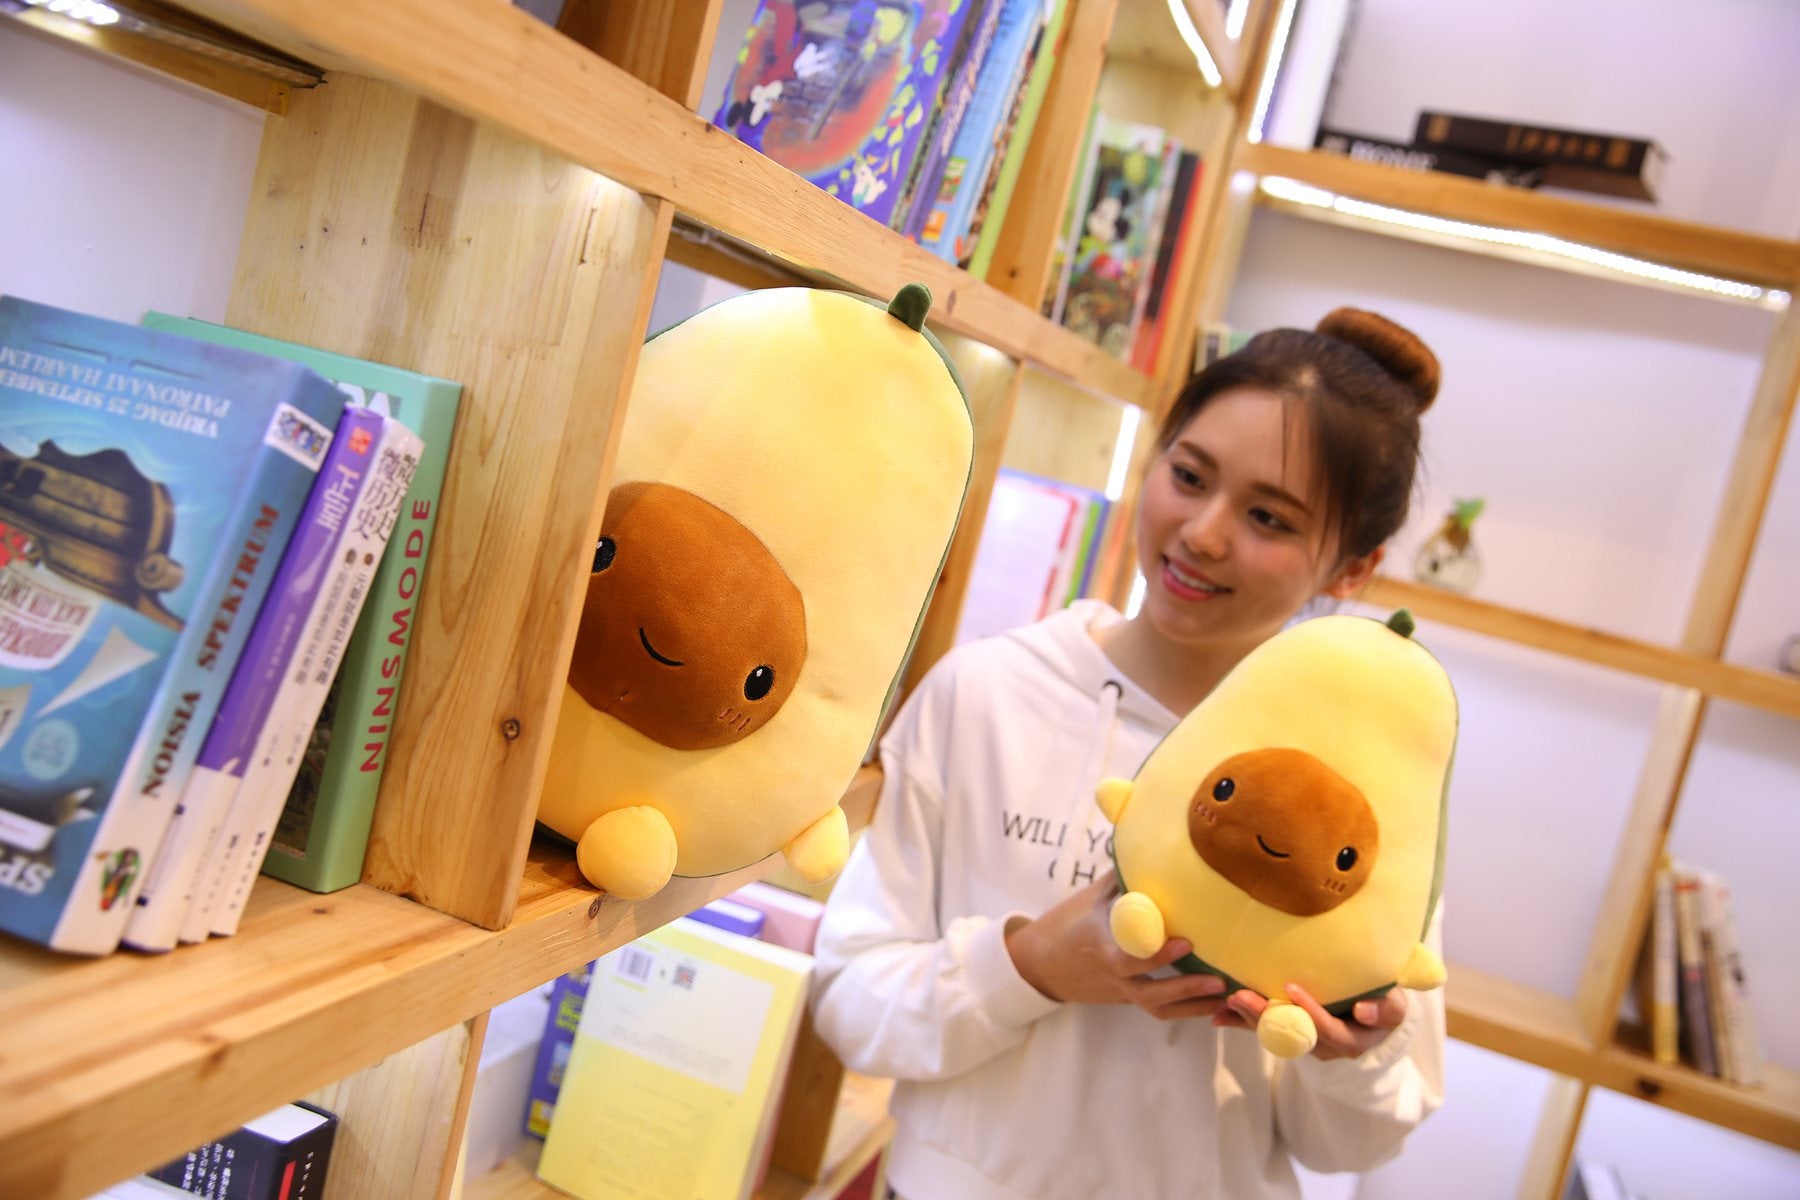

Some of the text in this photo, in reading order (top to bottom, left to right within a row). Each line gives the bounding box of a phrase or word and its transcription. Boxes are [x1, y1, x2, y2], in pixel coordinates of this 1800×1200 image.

[105, 372, 232, 418] PATRONAAT
[106, 395, 130, 416] 25
[133, 401, 219, 438] VRIJDAG
[140, 501, 281, 799] NOISIA SPEKTRUM
[359, 499, 432, 773] NINSMODE
